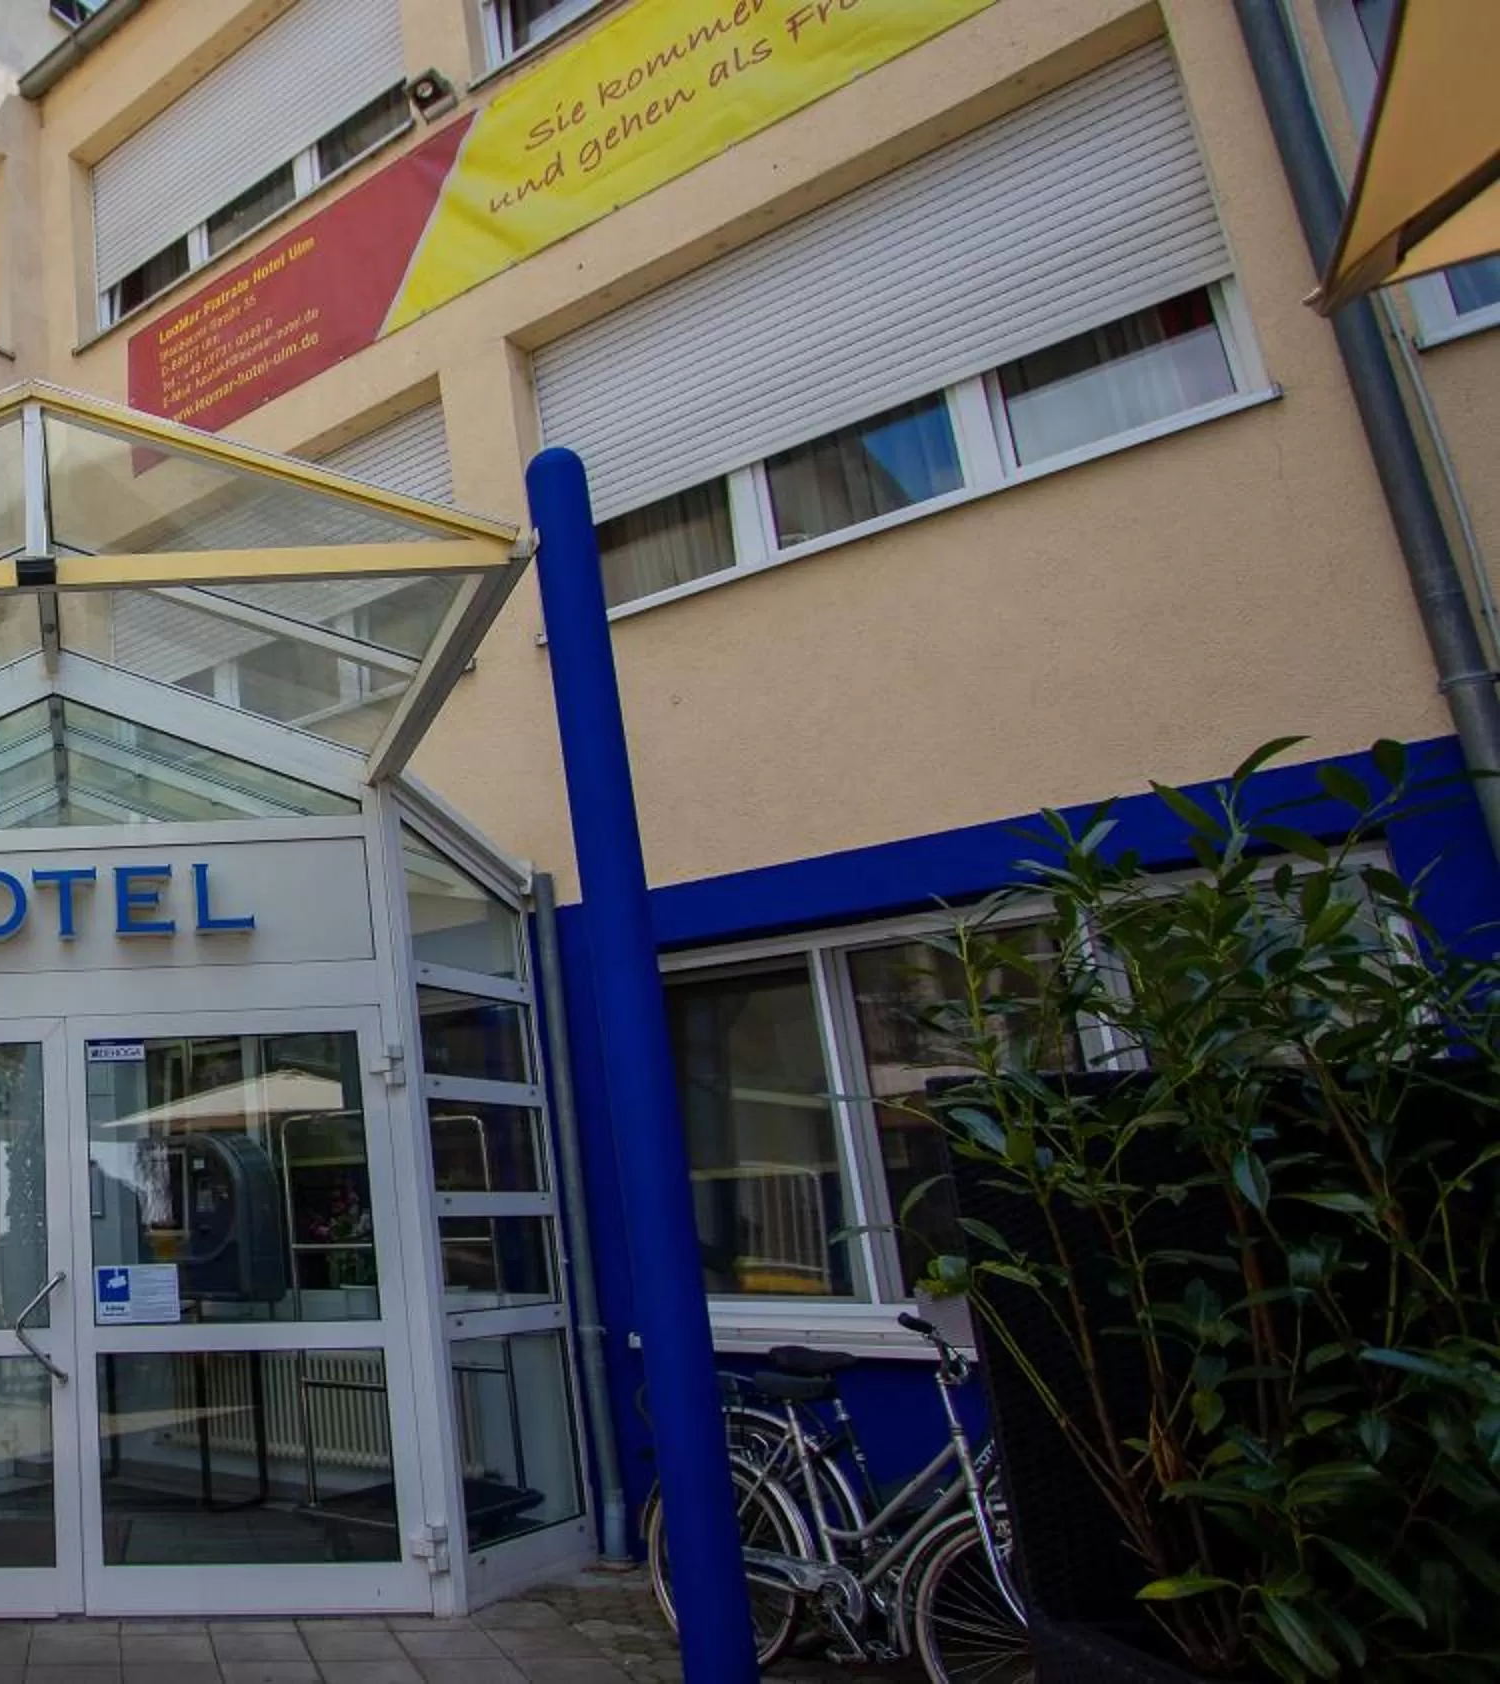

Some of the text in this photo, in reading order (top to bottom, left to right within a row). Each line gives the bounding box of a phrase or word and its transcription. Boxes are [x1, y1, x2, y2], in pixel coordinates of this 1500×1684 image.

[489, 152, 565, 213] und
[579, 88, 696, 173] gehen
[709, 38, 773, 88] als
[525, 101, 587, 151] Sie
[253, 251, 285, 285] Hotel
[288, 236, 315, 261] Ulm
